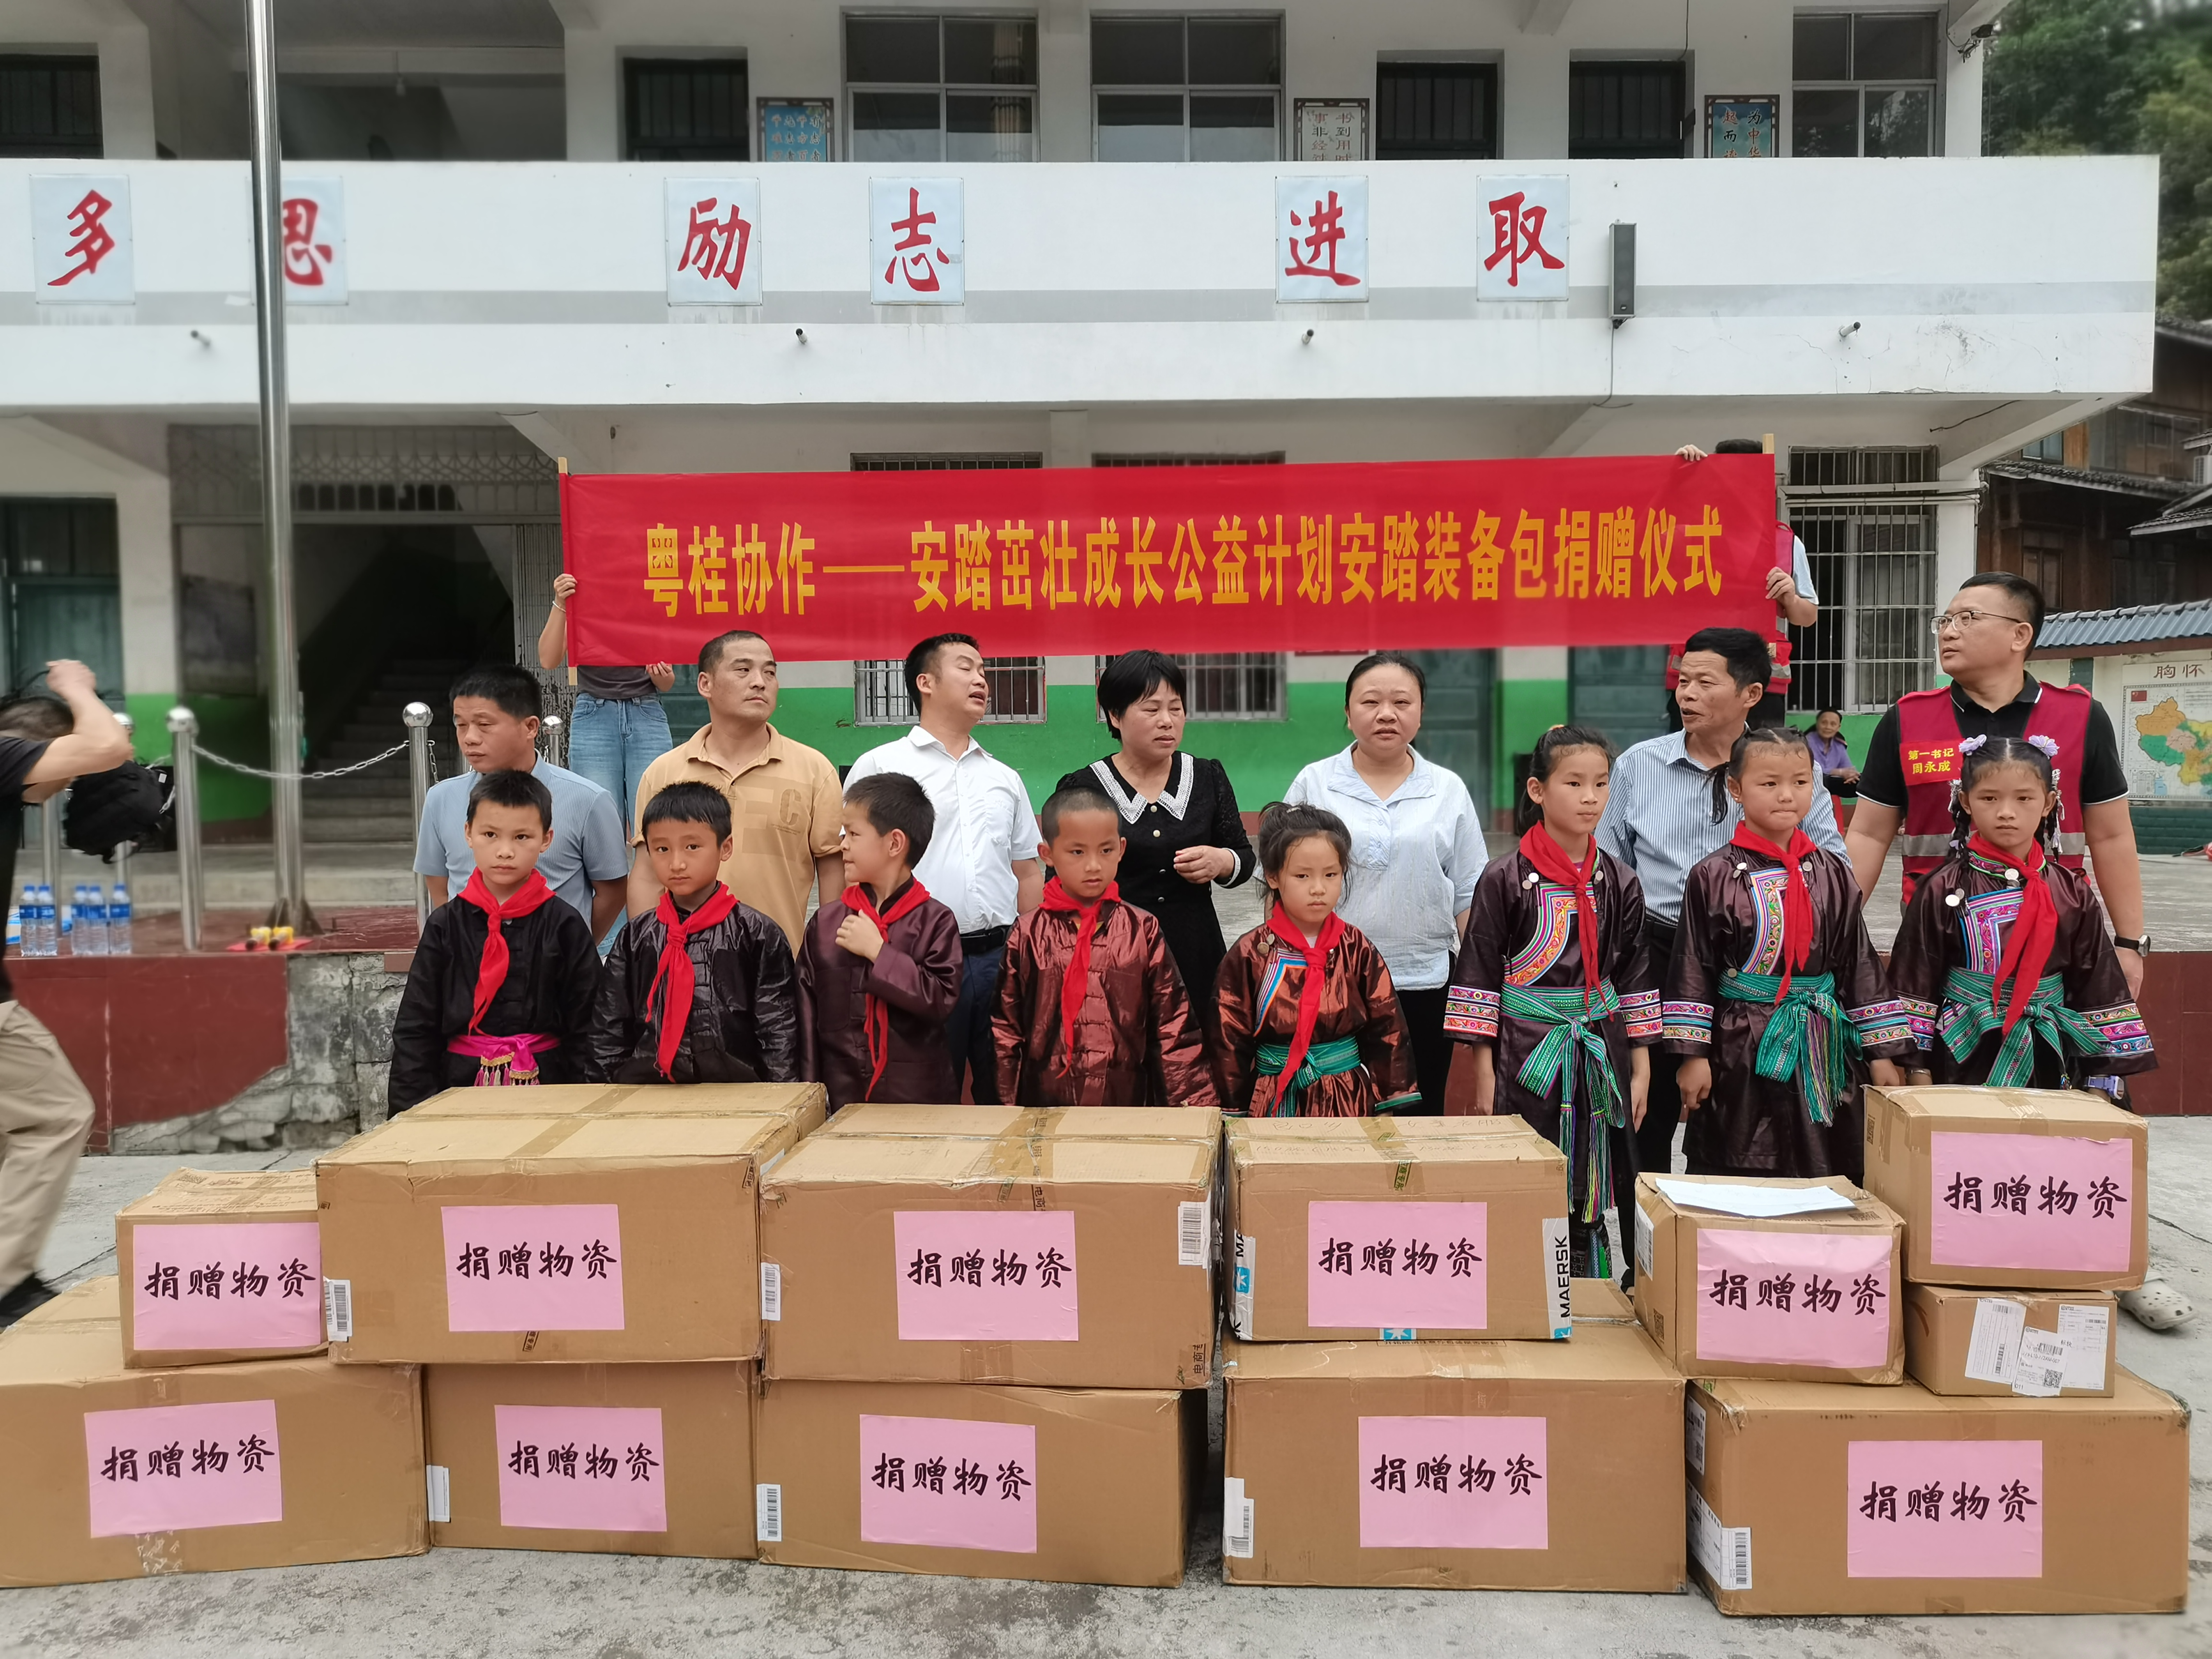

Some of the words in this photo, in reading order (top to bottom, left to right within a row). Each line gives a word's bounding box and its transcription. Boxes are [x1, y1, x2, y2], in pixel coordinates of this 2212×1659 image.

[2153, 664, 2212, 679] 胸怀
[1908, 748, 1954, 760] 第一书记
[1912, 760, 1951, 774] 周永成
[1034, 1187, 1046, 1211] 电商
[1944, 1172, 2128, 1218] 捐赠物资
[457, 1239, 617, 1280] 捐赠物资
[907, 1247, 1072, 1288] 捐赠物资
[1319, 1238, 1482, 1277] 捐赠物资
[1555, 1235, 1570, 1318] MAERSK
[144, 1258, 316, 1300] 捐赠物资
[1709, 1269, 1886, 1315] 捐赠物资
[101, 1434, 275, 1482] 捐赠物资
[508, 1440, 660, 1481] 捐赠物资
[872, 1453, 1032, 1501] 捐赠物资
[1370, 1453, 1542, 1495] 捐赠物资
[1860, 1479, 2037, 1523] 捐赠物资
